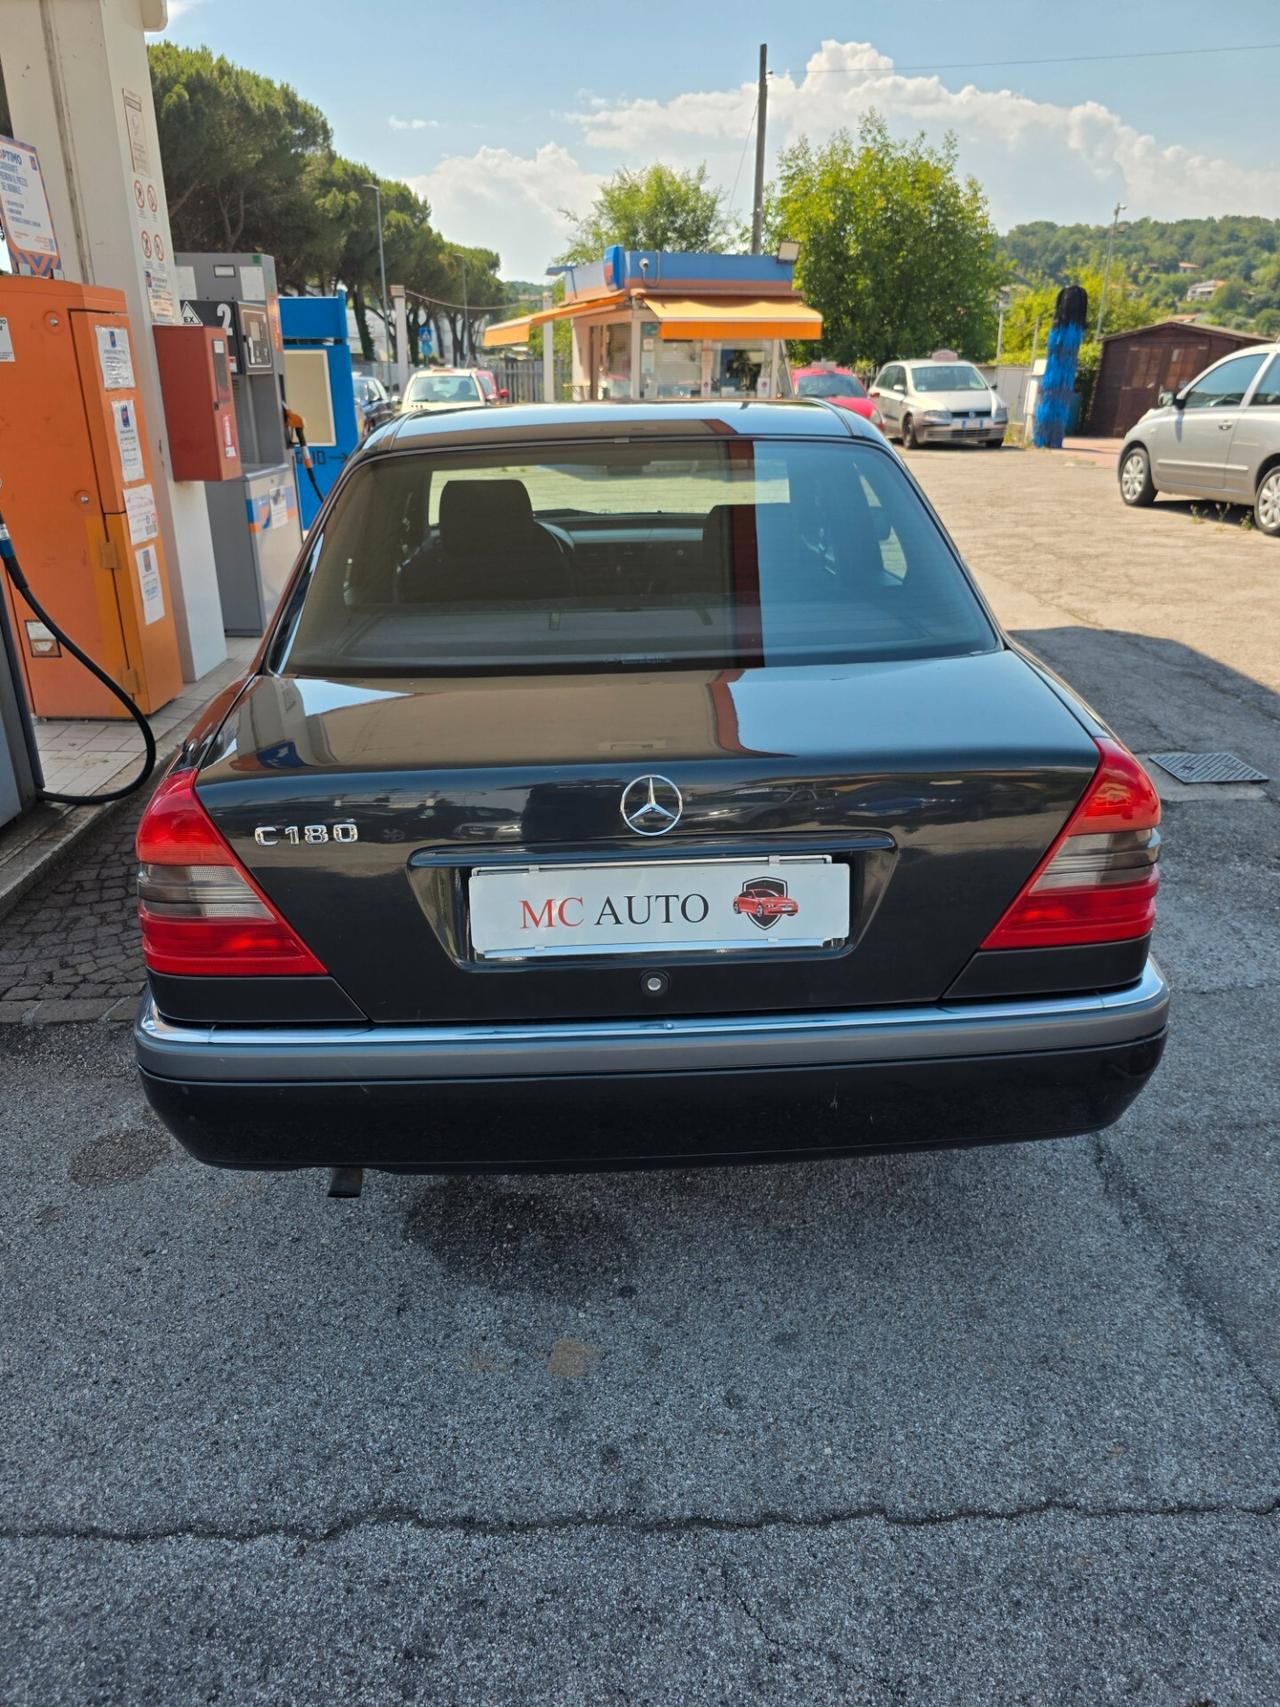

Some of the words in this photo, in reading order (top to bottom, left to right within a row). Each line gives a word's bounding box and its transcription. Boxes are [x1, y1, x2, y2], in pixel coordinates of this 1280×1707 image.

[217, 303, 233, 336] 2
[520, 897, 584, 929] MC
[594, 893, 709, 926] AUTO
